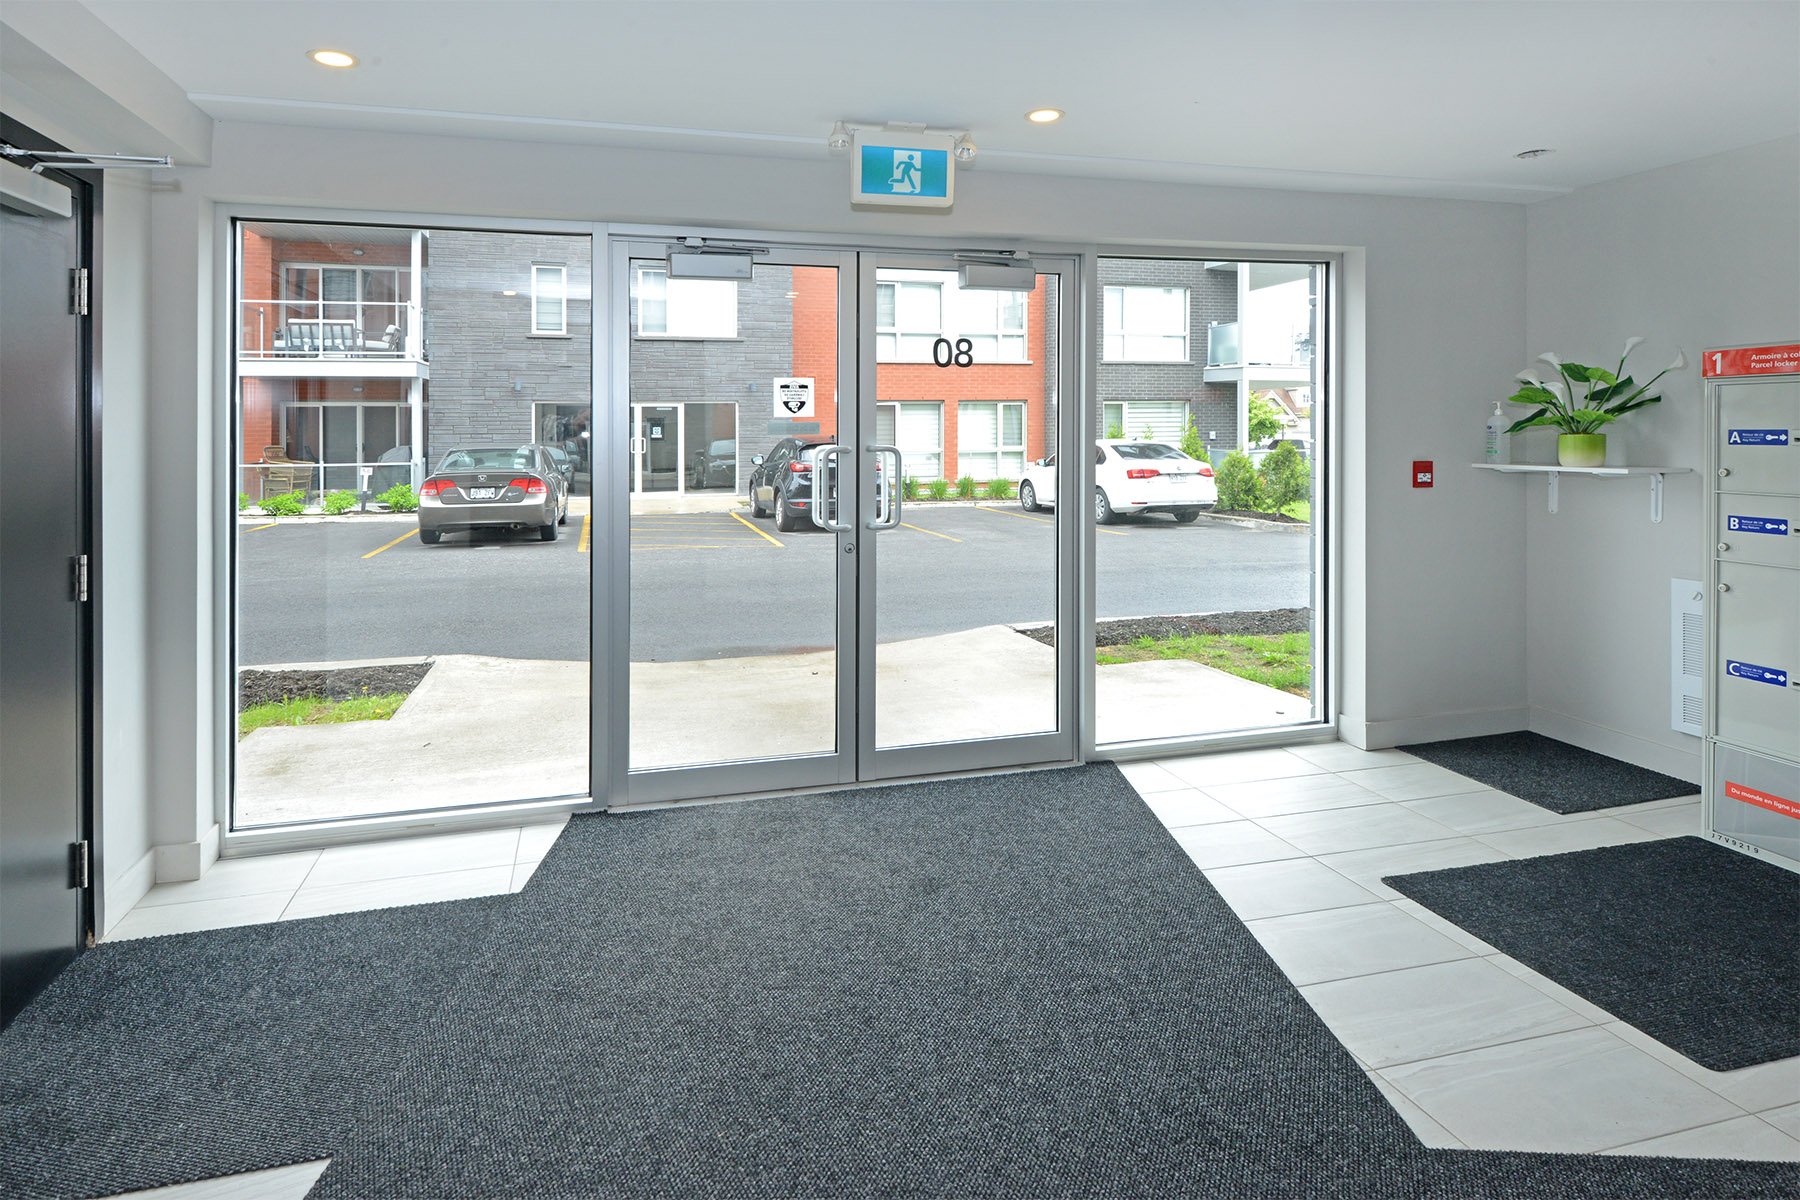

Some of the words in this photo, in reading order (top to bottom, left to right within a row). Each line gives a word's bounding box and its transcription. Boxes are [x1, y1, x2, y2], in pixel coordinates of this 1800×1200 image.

[1712, 352, 1722, 374] 1
[1751, 353, 1781, 361] Armoire
[1729, 431, 1742, 443] A
[1730, 517, 1739, 529] B
[1729, 663, 1740, 675] C
[1731, 787, 1741, 795] Du
[1741, 791, 1763, 802] monde
[1773, 800, 1790, 811] ligne
